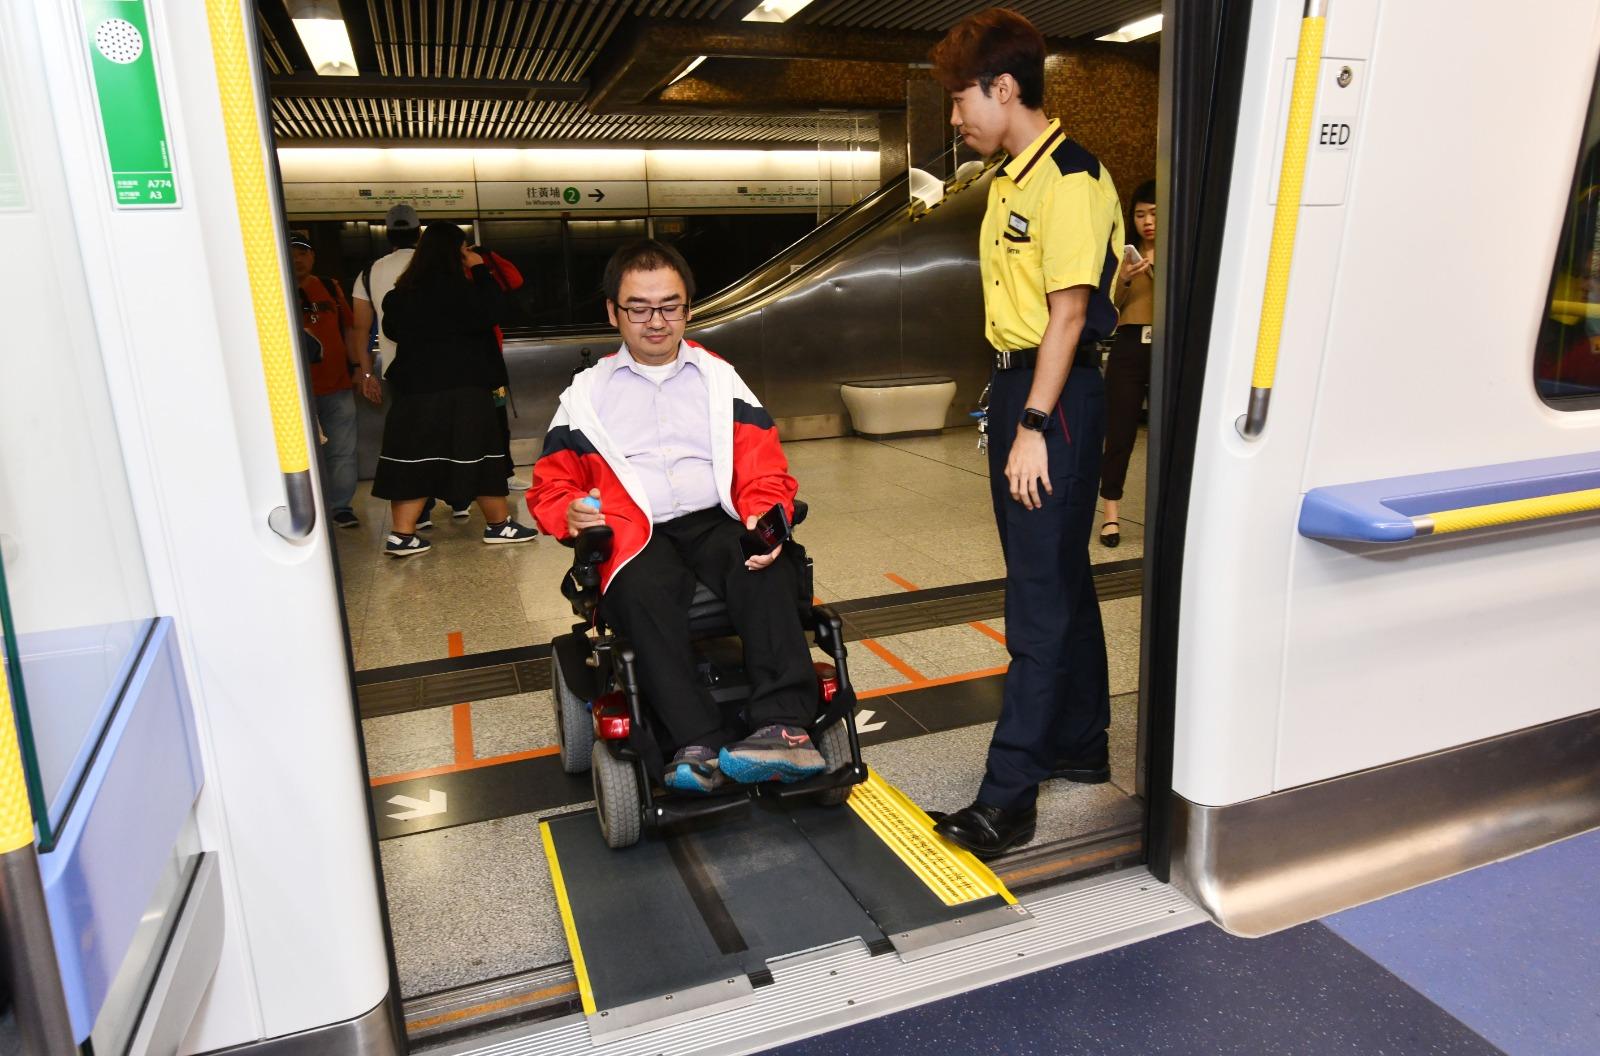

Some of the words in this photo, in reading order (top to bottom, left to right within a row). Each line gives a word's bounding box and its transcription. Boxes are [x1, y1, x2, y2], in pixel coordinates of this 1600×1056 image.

[1320, 124, 1350, 145] EED
[148, 180, 171, 188] A774
[150, 191, 162, 199] A3
[527, 187, 560, 198] 往黃埔
